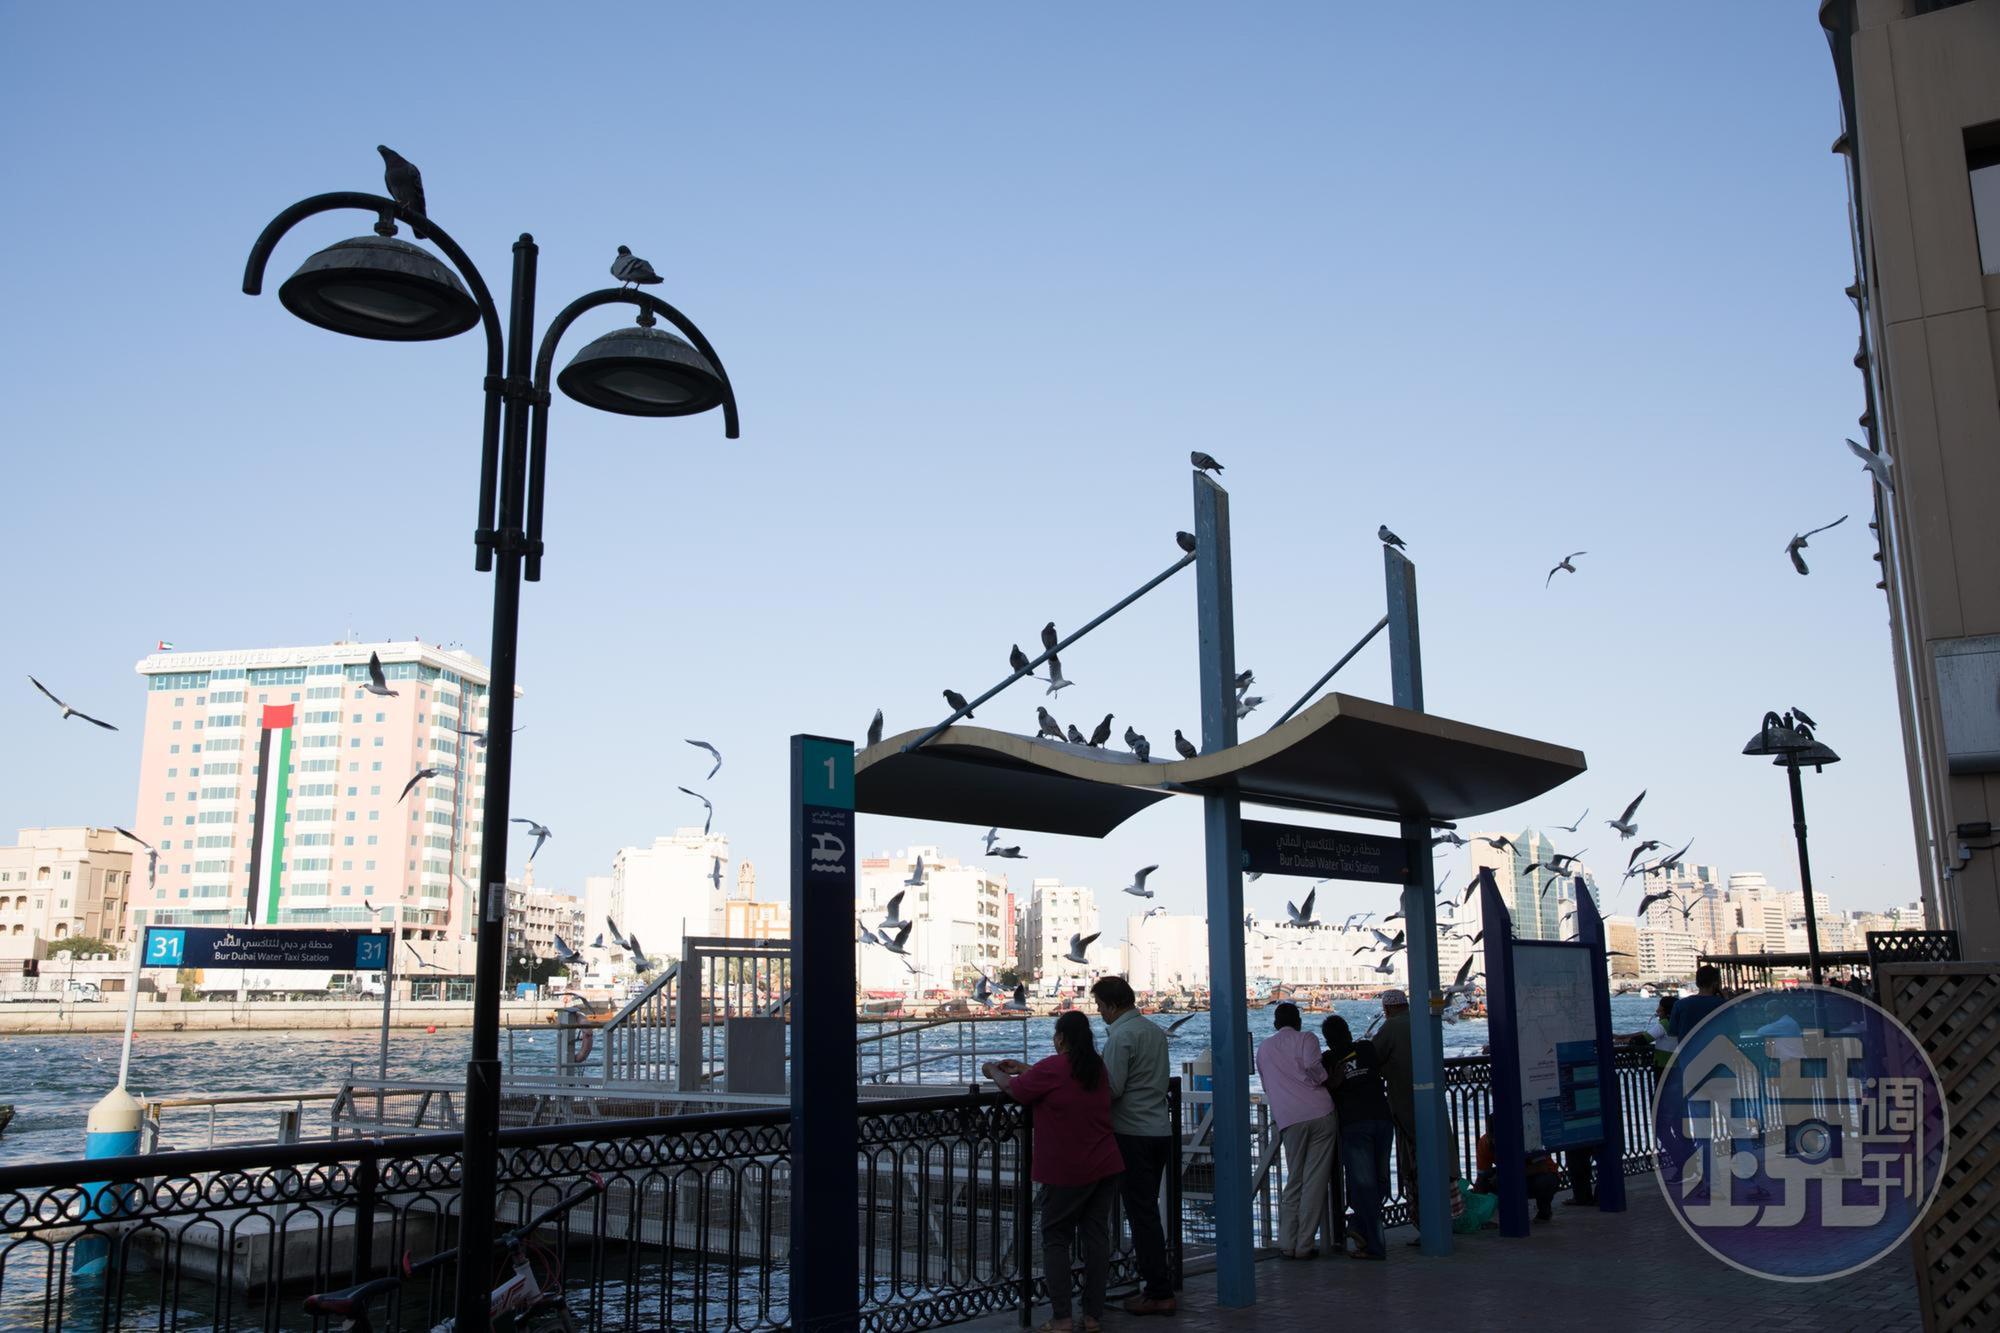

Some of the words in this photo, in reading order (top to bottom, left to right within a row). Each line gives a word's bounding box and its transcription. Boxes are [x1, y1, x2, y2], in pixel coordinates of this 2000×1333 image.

[824, 756, 835, 790] 1
[1279, 853, 1293, 866] Bur
[1294, 855, 1316, 868] Dubai
[1316, 857, 1339, 870] Water
[1339, 859, 1354, 872] Taxi
[1354, 861, 1380, 875] Station
[152, 937, 179, 958] 31
[214, 951, 229, 960] Bur
[231, 951, 256, 961] Dubai
[257, 952, 282, 961] Water
[284, 953, 300, 961] Taxi
[301, 952, 329, 962] Station
[361, 941, 382, 961] 31
